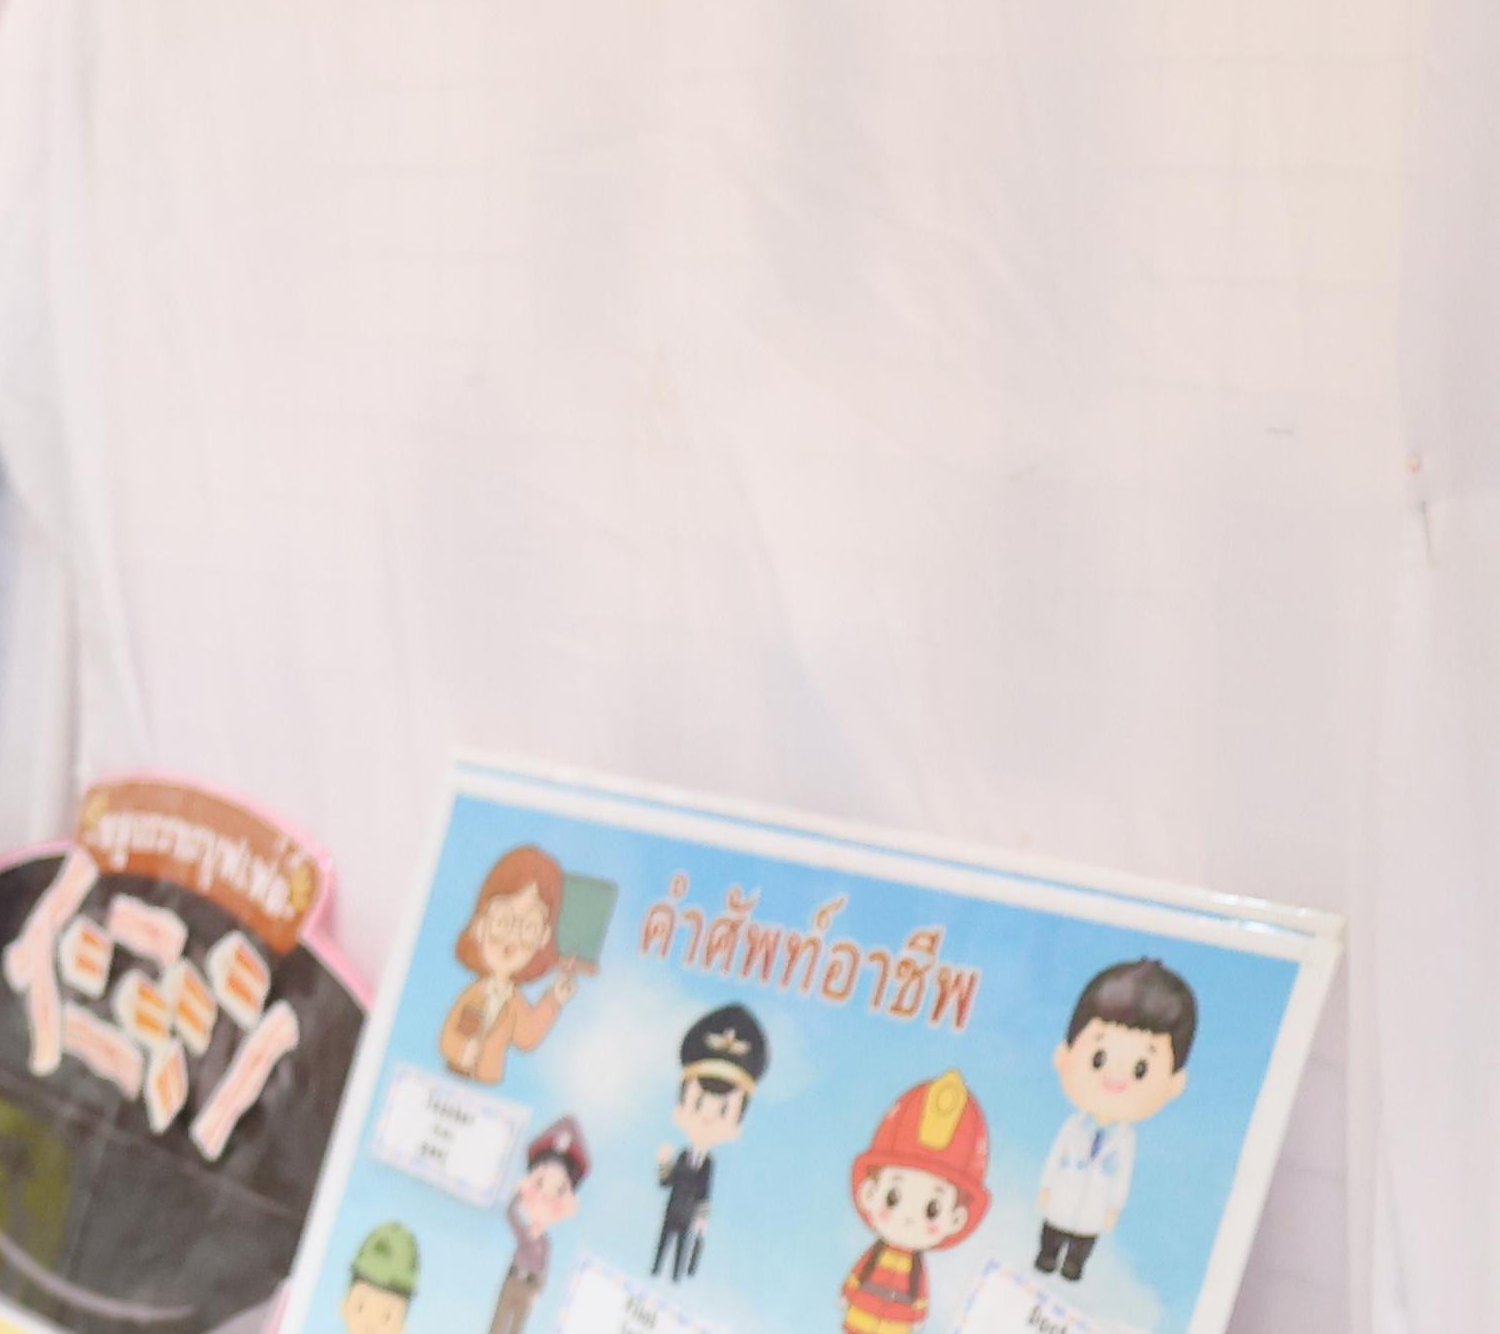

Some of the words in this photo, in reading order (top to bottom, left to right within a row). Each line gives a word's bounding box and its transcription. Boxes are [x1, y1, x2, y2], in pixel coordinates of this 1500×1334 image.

[636, 873, 982, 1034] คำศัพท์อาชีพ
